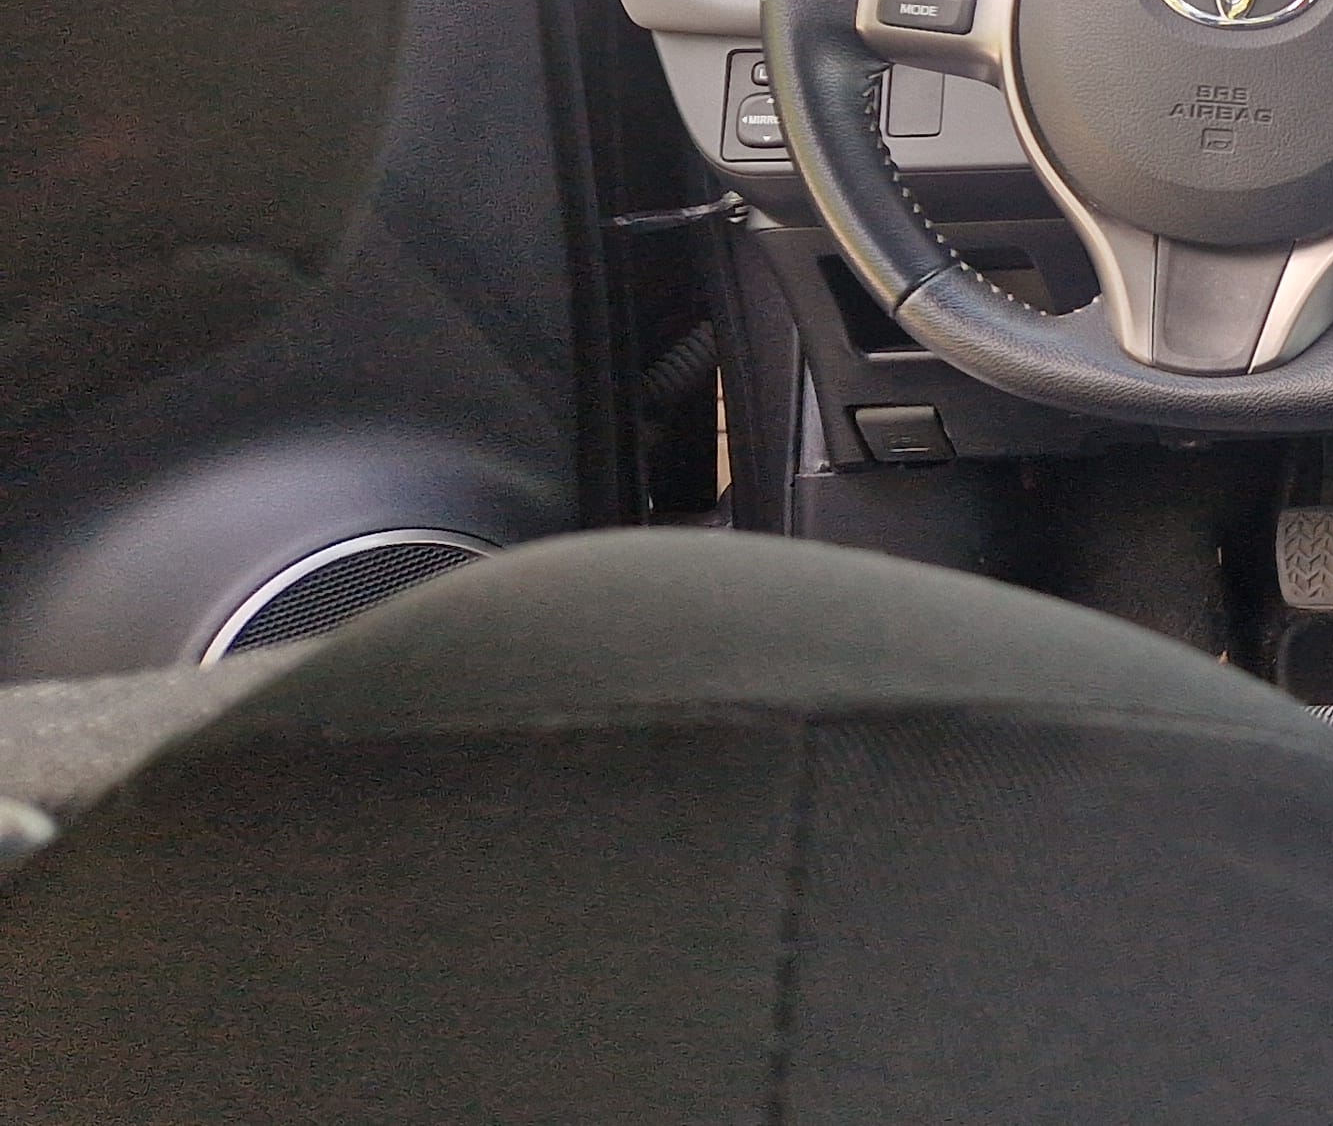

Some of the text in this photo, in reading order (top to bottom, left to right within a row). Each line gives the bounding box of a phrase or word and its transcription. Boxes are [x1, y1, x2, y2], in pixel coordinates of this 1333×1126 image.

[900, 3, 939, 16] MODE
[1196, 84, 1249, 100] SRS
[1168, 103, 1274, 125] AIRBAG
